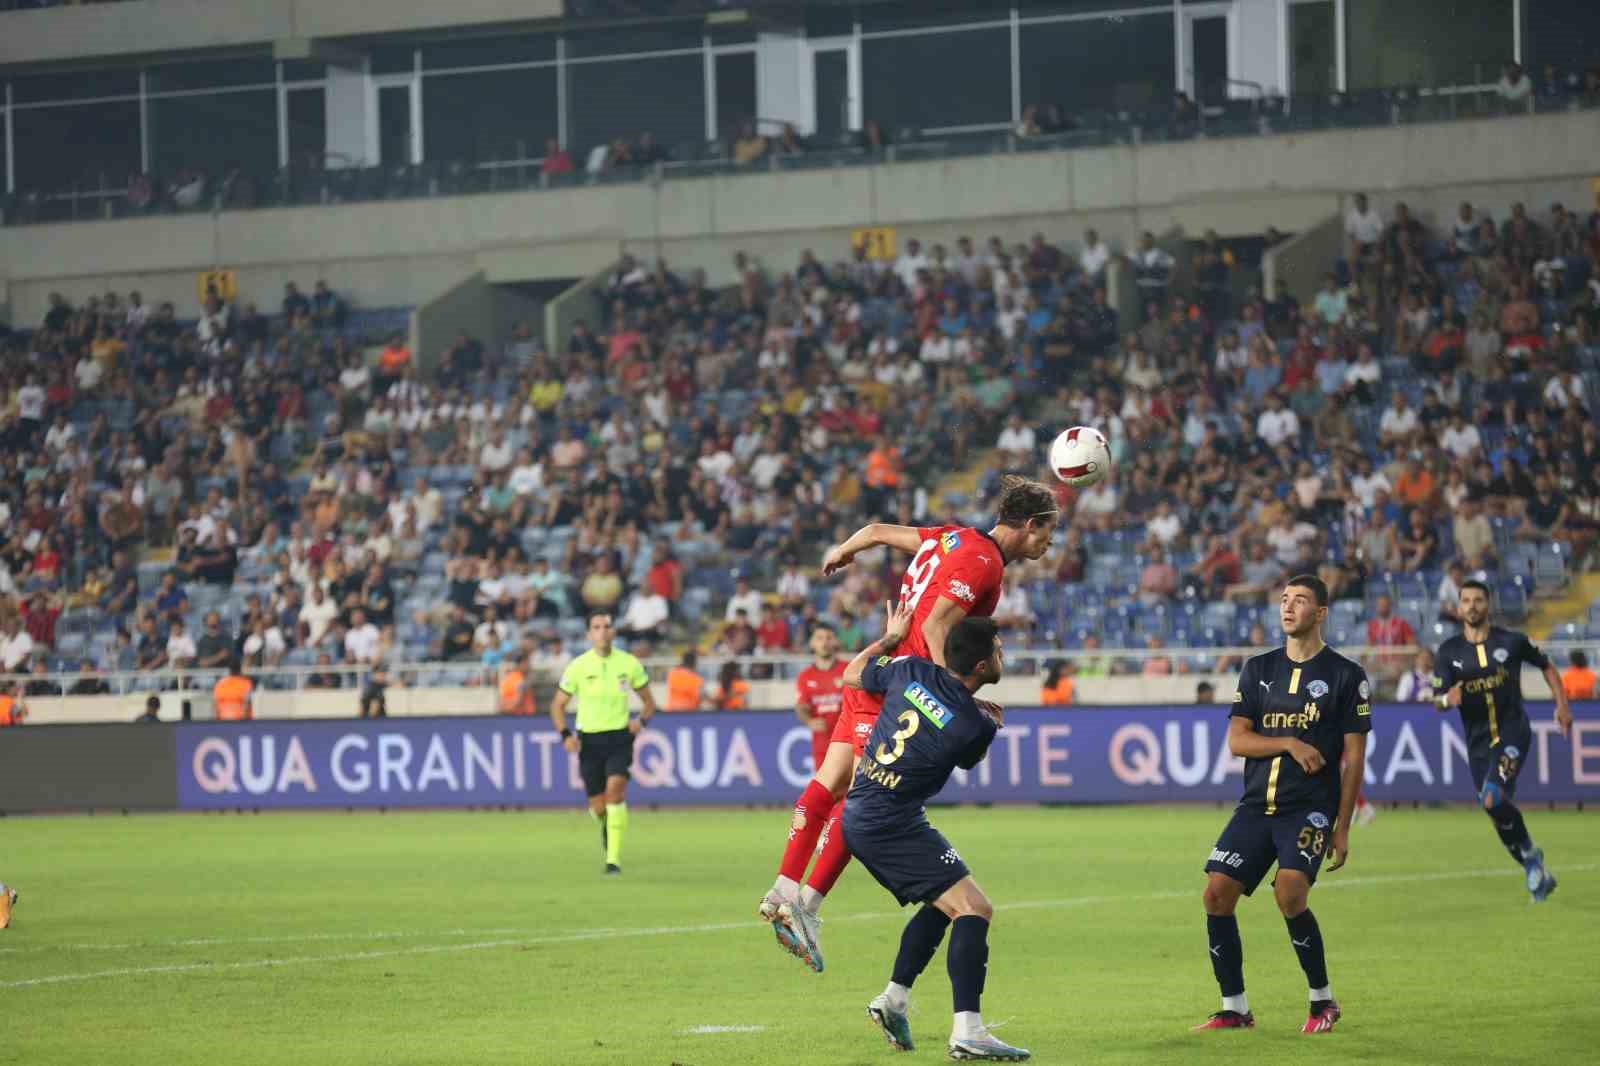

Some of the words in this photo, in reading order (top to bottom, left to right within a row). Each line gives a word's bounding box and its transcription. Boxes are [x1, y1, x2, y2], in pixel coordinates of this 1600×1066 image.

[910, 686, 945, 720] aksa
[193, 735, 317, 794] QUA
[631, 725, 763, 789] QUA
[875, 709, 920, 766] 3
[1297, 826, 1324, 856] 58
